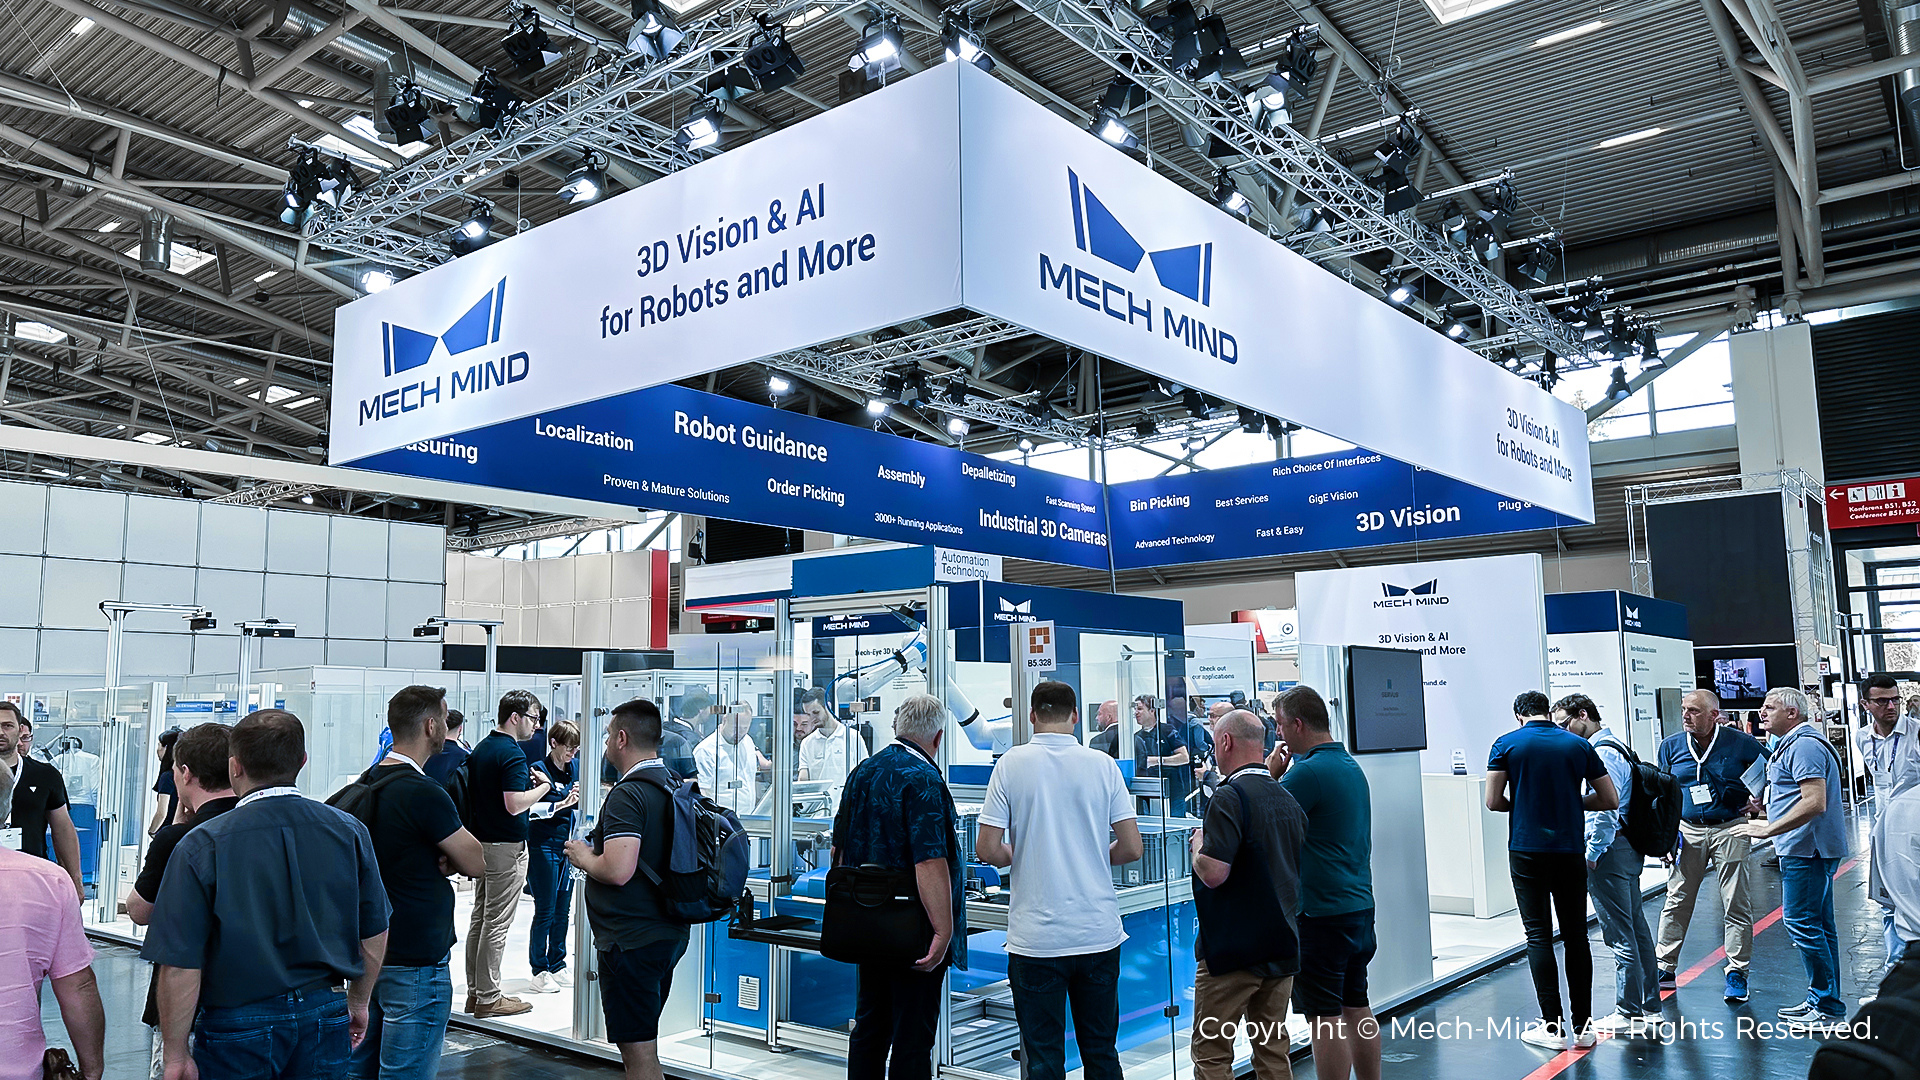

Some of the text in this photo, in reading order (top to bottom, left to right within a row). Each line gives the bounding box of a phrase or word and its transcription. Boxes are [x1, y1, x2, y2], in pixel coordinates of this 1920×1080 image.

[638, 183, 824, 277] 3D Vision & AI
[601, 225, 875, 338] for Robots and More
[1039, 253, 1238, 365] MECH MIND
[360, 350, 530, 426] MECH MIND
[536, 418, 633, 451] Localization
[675, 411, 827, 462] Robot Guidance
[1507, 408, 1559, 448] 3D Vision & AI
[401, 438, 478, 464] asuring
[1497, 433, 1572, 482] for Robots and More
[962, 462, 1016, 487] Depalletizing
[1273, 453, 1381, 476] Rich Choice Of Interfaces
[878, 465, 925, 488] Assembly
[604, 474, 729, 503] Proven & Mature Solutions
[768, 478, 844, 507] Order Picking
[1309, 491, 1358, 504] GigE Vision
[1046, 496, 1095, 513] Fast Scanning Speed
[1131, 495, 1189, 511] Bin Picking
[1216, 495, 1268, 507] Best Services
[1498, 501, 1521, 512] Plug
[875, 513, 963, 534] 3000+ Running Applications
[980, 509, 1106, 546] Industrial 3D Cameras
[1357, 505, 1460, 531] 3D Vision
[1135, 534, 1214, 548] Advanced Technology
[1257, 526, 1303, 537] Fast & Easy
[941, 551, 989, 567] Automation
[941, 562, 989, 580] Technology
[1373, 597, 1450, 609] MECH MIND
[994, 613, 1037, 623] MECH MIND
[1378, 632, 1449, 644] 3D Vision & AI
[882, 647, 891, 655] 3D
[1440, 646, 1465, 654] More
[1027, 659, 1052, 667] B5.328
